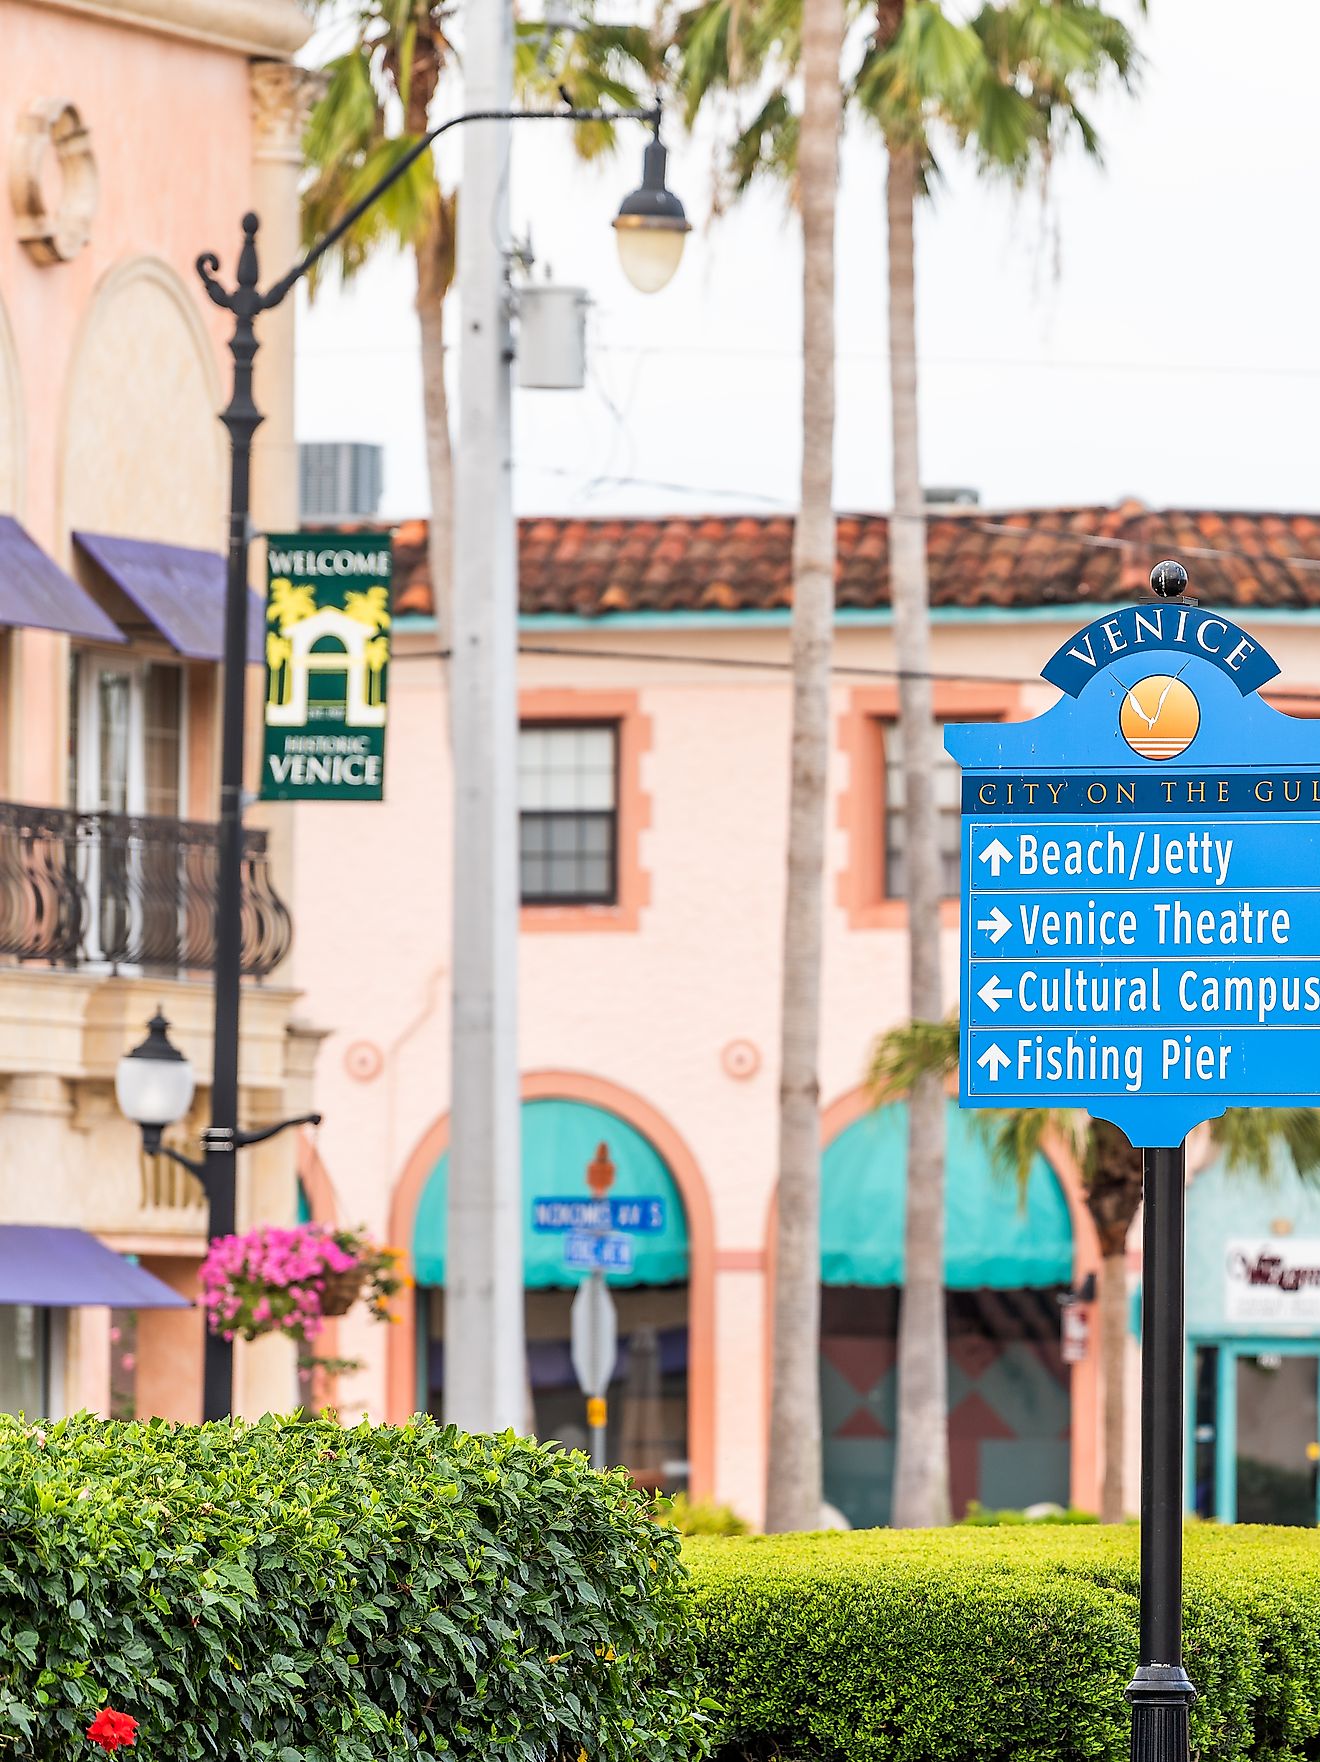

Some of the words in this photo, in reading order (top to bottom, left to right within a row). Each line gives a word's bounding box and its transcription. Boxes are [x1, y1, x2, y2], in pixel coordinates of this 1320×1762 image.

[268, 550, 392, 576] WELCOME
[1065, 608, 1256, 672] VENICE
[269, 754, 381, 785] VENICE
[978, 783, 1065, 805] CITY
[1086, 782, 1136, 804] ON
[1160, 781, 1230, 803] THE
[1017, 831, 1233, 886] Beach/Jetty
[1019, 900, 1137, 946] Venice
[1154, 901, 1290, 945] Theatre
[1018, 967, 1161, 1012] Cultural
[1178, 970, 1320, 1023] Campus
[1017, 1038, 1143, 1092] Fishing
[1162, 1036, 1232, 1080] Pier
